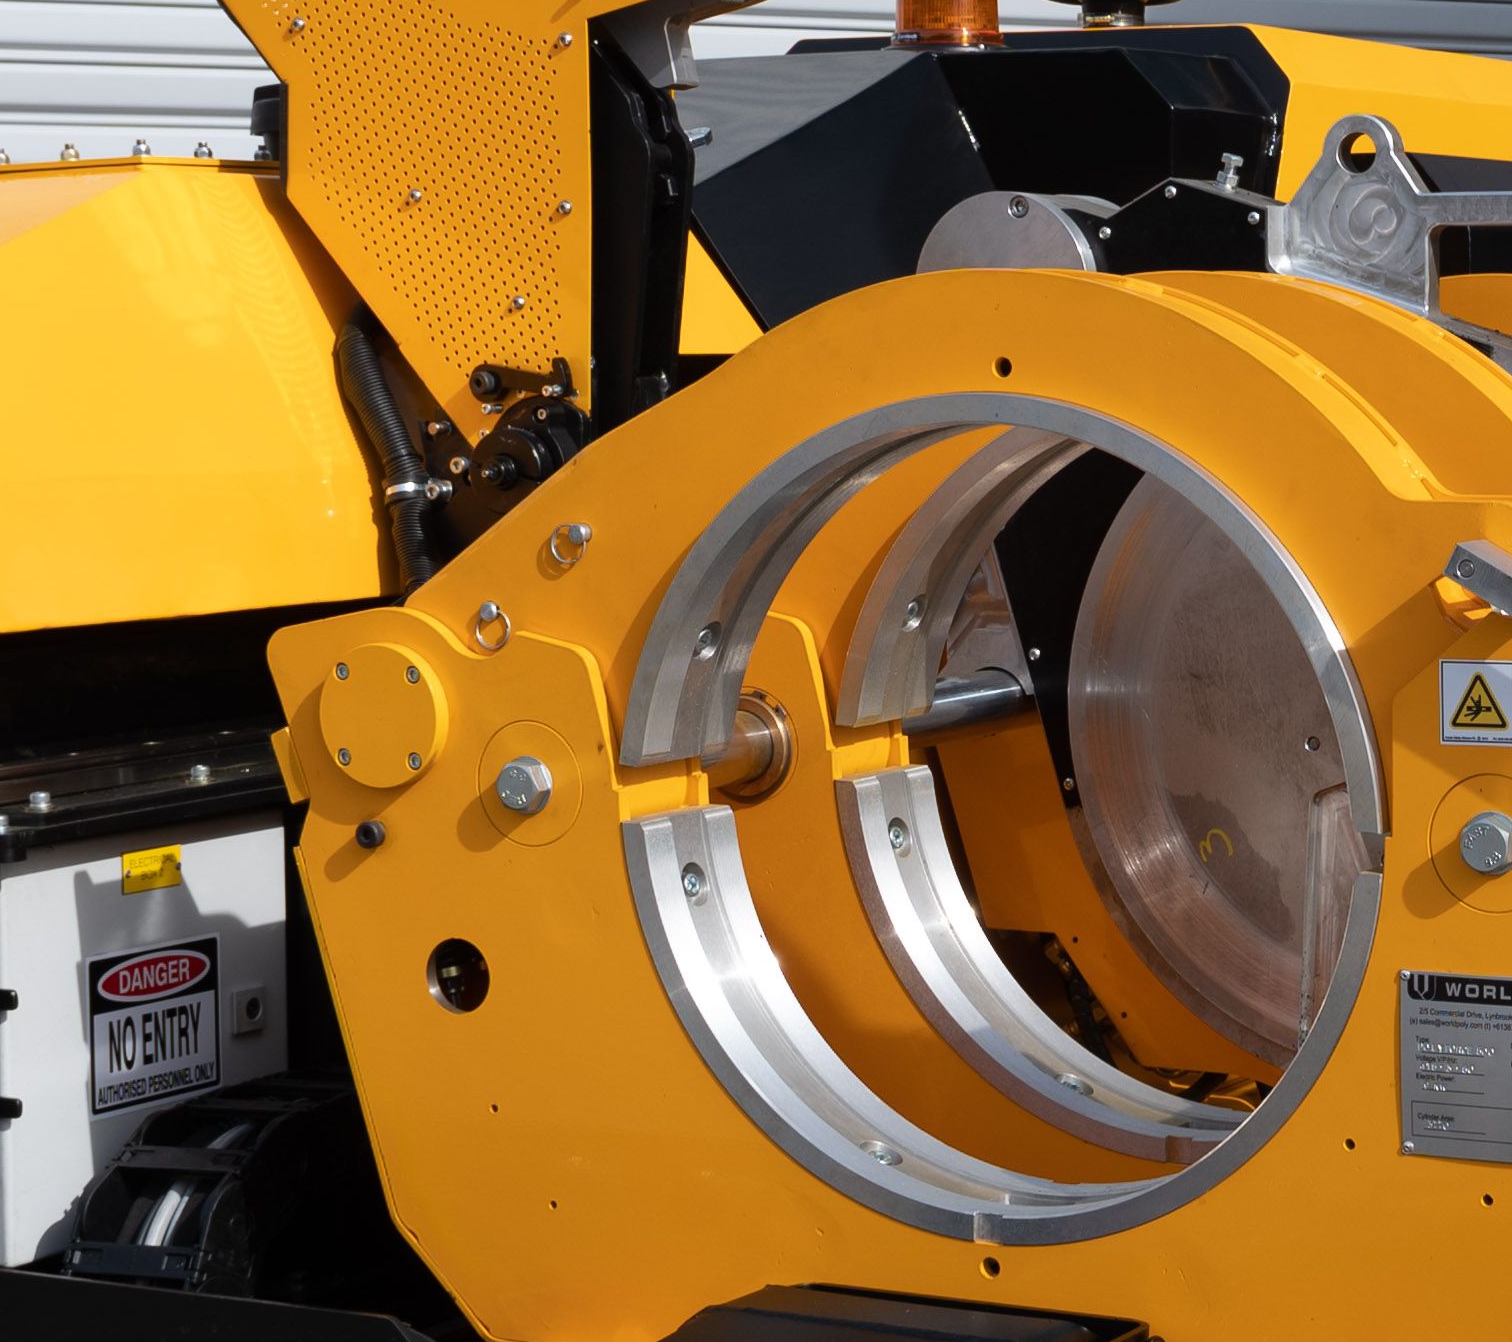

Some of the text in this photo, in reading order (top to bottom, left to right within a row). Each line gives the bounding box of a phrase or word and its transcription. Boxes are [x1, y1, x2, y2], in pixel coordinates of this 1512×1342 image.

[119, 958, 190, 994] DANGER
[1419, 1018, 1483, 1030] sales@worldpoly.com
[1430, 1008, 1465, 1017] Commercial
[108, 1001, 202, 1073] NO ENTRY
[98, 1061, 216, 1106] AUTHORISED PERSONNEL ONLY
